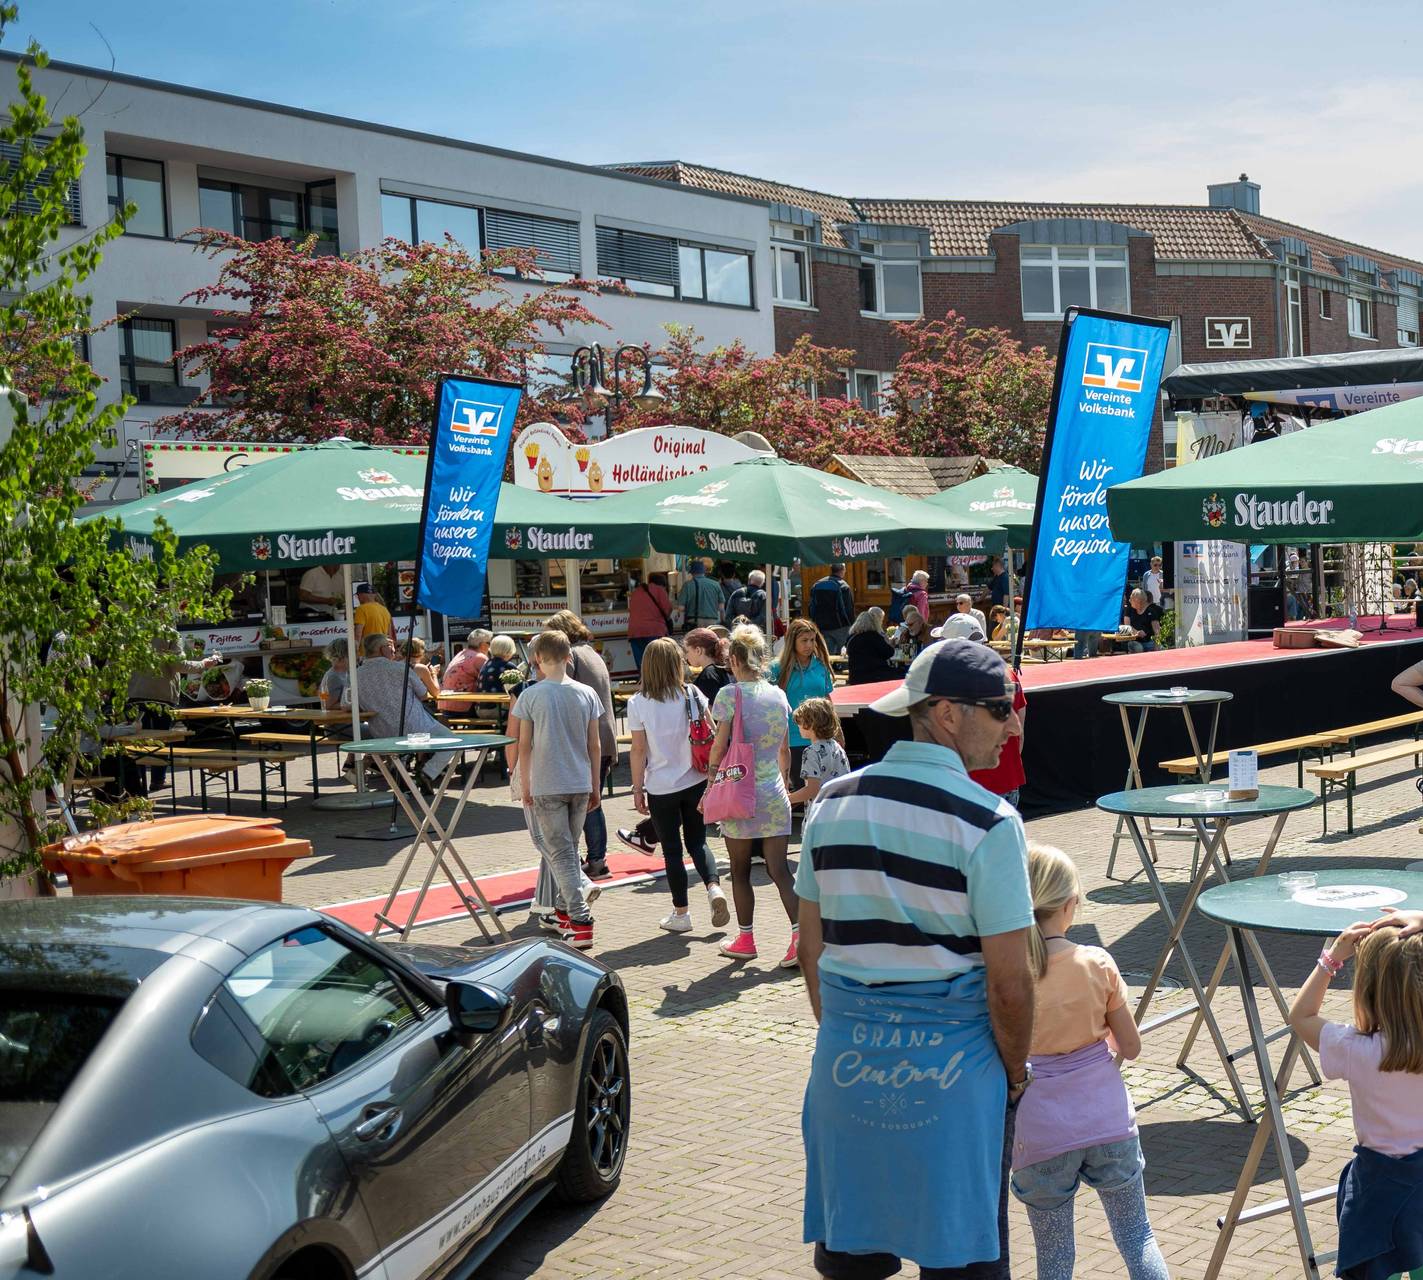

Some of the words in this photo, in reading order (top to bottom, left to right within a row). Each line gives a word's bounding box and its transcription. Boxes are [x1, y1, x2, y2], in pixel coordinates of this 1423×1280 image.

[1085, 389, 1132, 405] Vereinte
[1344, 391, 1401, 405] Vereinte
[1079, 402, 1136, 418] Volksbank
[449, 443, 493, 456] Volksbank
[453, 434, 490, 446] Vereinte
[654, 435, 706, 458] Original
[1079, 458, 1113, 481] Wir
[450, 485, 477, 503] Wir
[1058, 484, 1108, 512] förde
[434, 503, 484, 523] fördern
[1234, 489, 1330, 530] Stauder
[434, 526, 477, 539] unsere
[527, 526, 594, 552] Stauder
[709, 531, 756, 555] Stauder
[954, 531, 985, 551] Stauder
[277, 530, 356, 561] Stauder
[432, 541, 477, 566] Region.
[843, 534, 880, 558] Stauder
[1051, 533, 1117, 567] Region.
[208, 634, 243, 645] Fajitas
[852, 1022, 944, 1048] GRAND
[832, 1050, 965, 1090] Central
